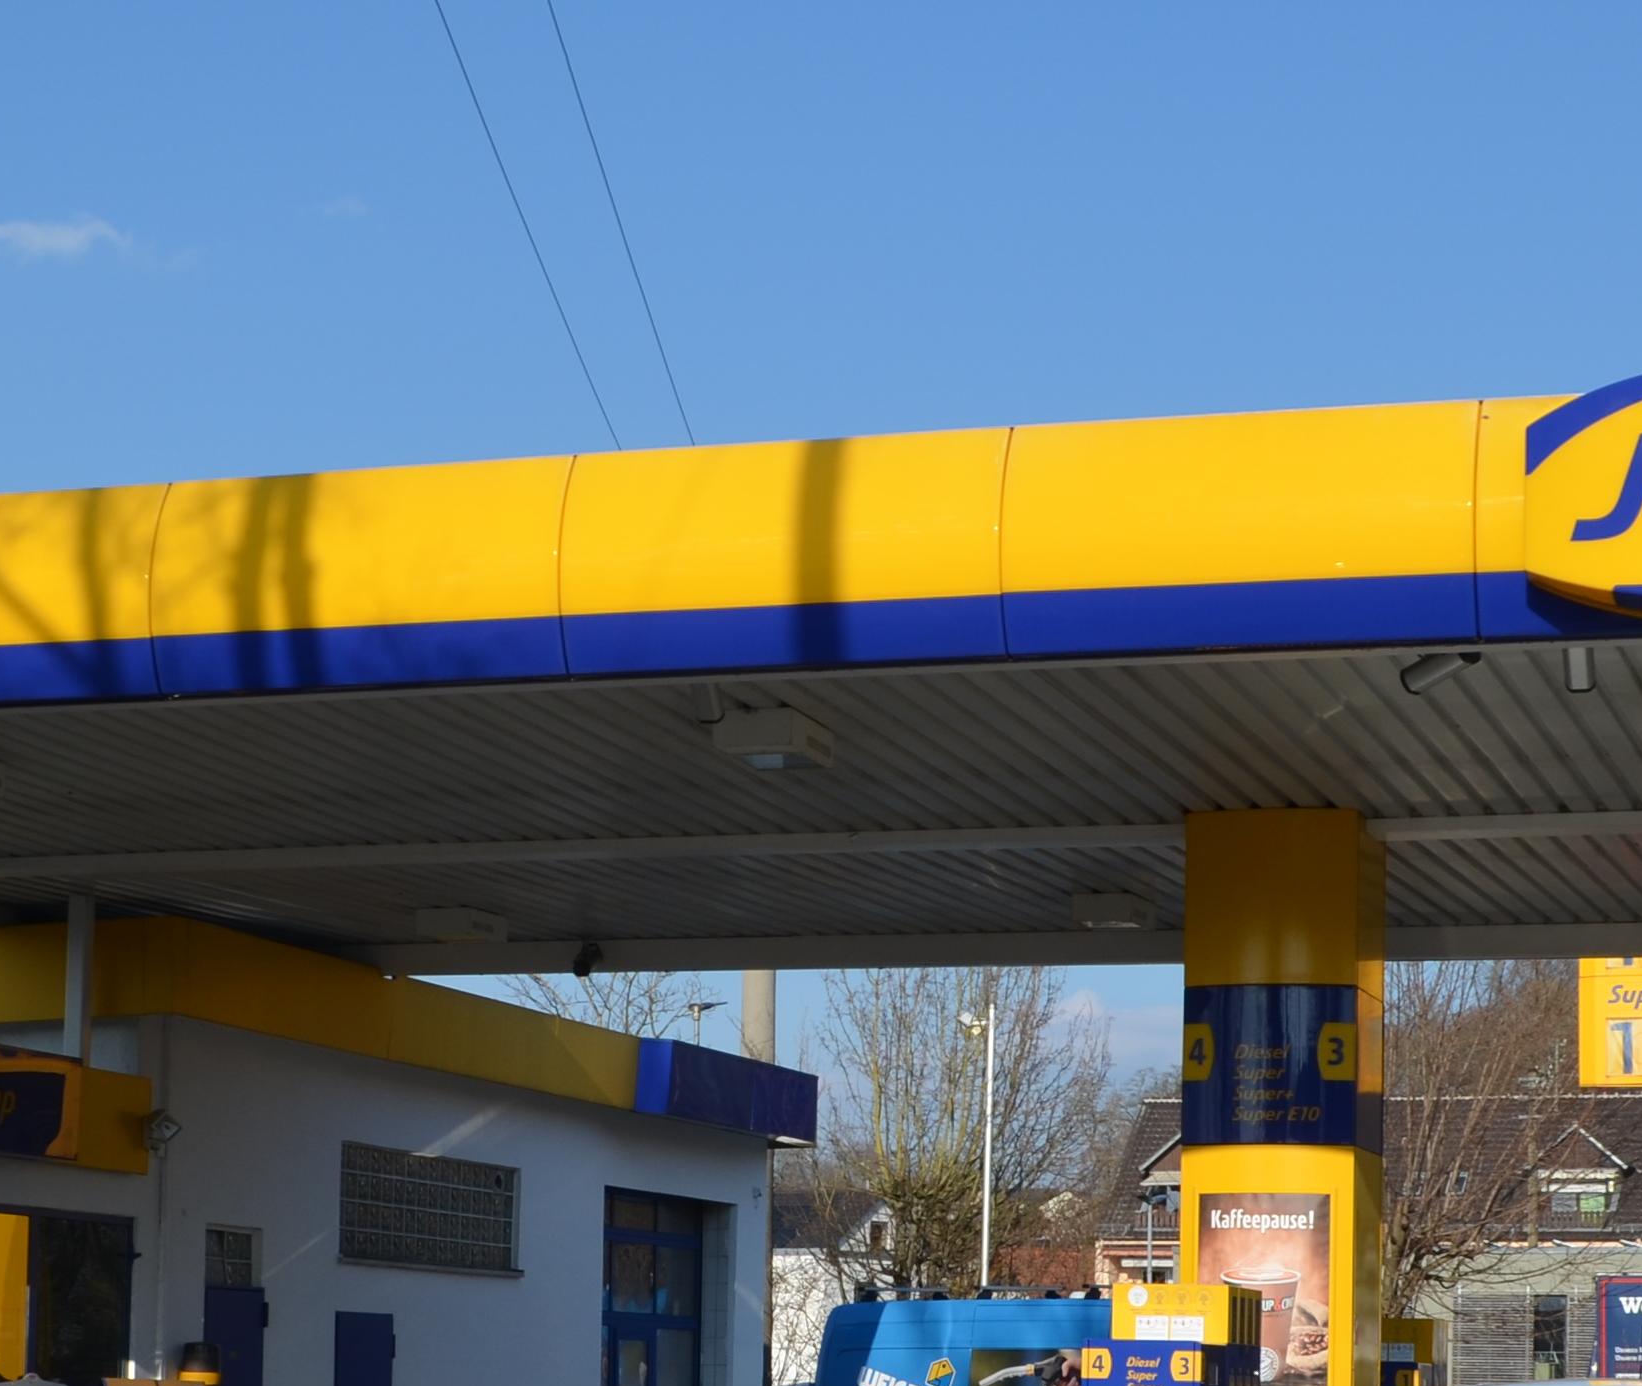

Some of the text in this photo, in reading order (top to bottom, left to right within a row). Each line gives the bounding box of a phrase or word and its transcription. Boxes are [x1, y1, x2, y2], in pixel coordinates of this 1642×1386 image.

[1188, 1037, 1206, 1066] 4
[1234, 1044, 1292, 1060] Diesel
[1327, 1037, 1345, 1066] 3
[1234, 1066, 1286, 1086] Super
[1234, 1087, 1295, 1106] Super+
[1232, 1107, 1321, 1126] Super E10
[1210, 1209, 1315, 1234] Kaffeepause!
[1091, 1354, 1105, 1373] 4
[1126, 1356, 1161, 1369] Diesel
[1178, 1357, 1190, 1376] 3
[1126, 1370, 1158, 1383] Super
